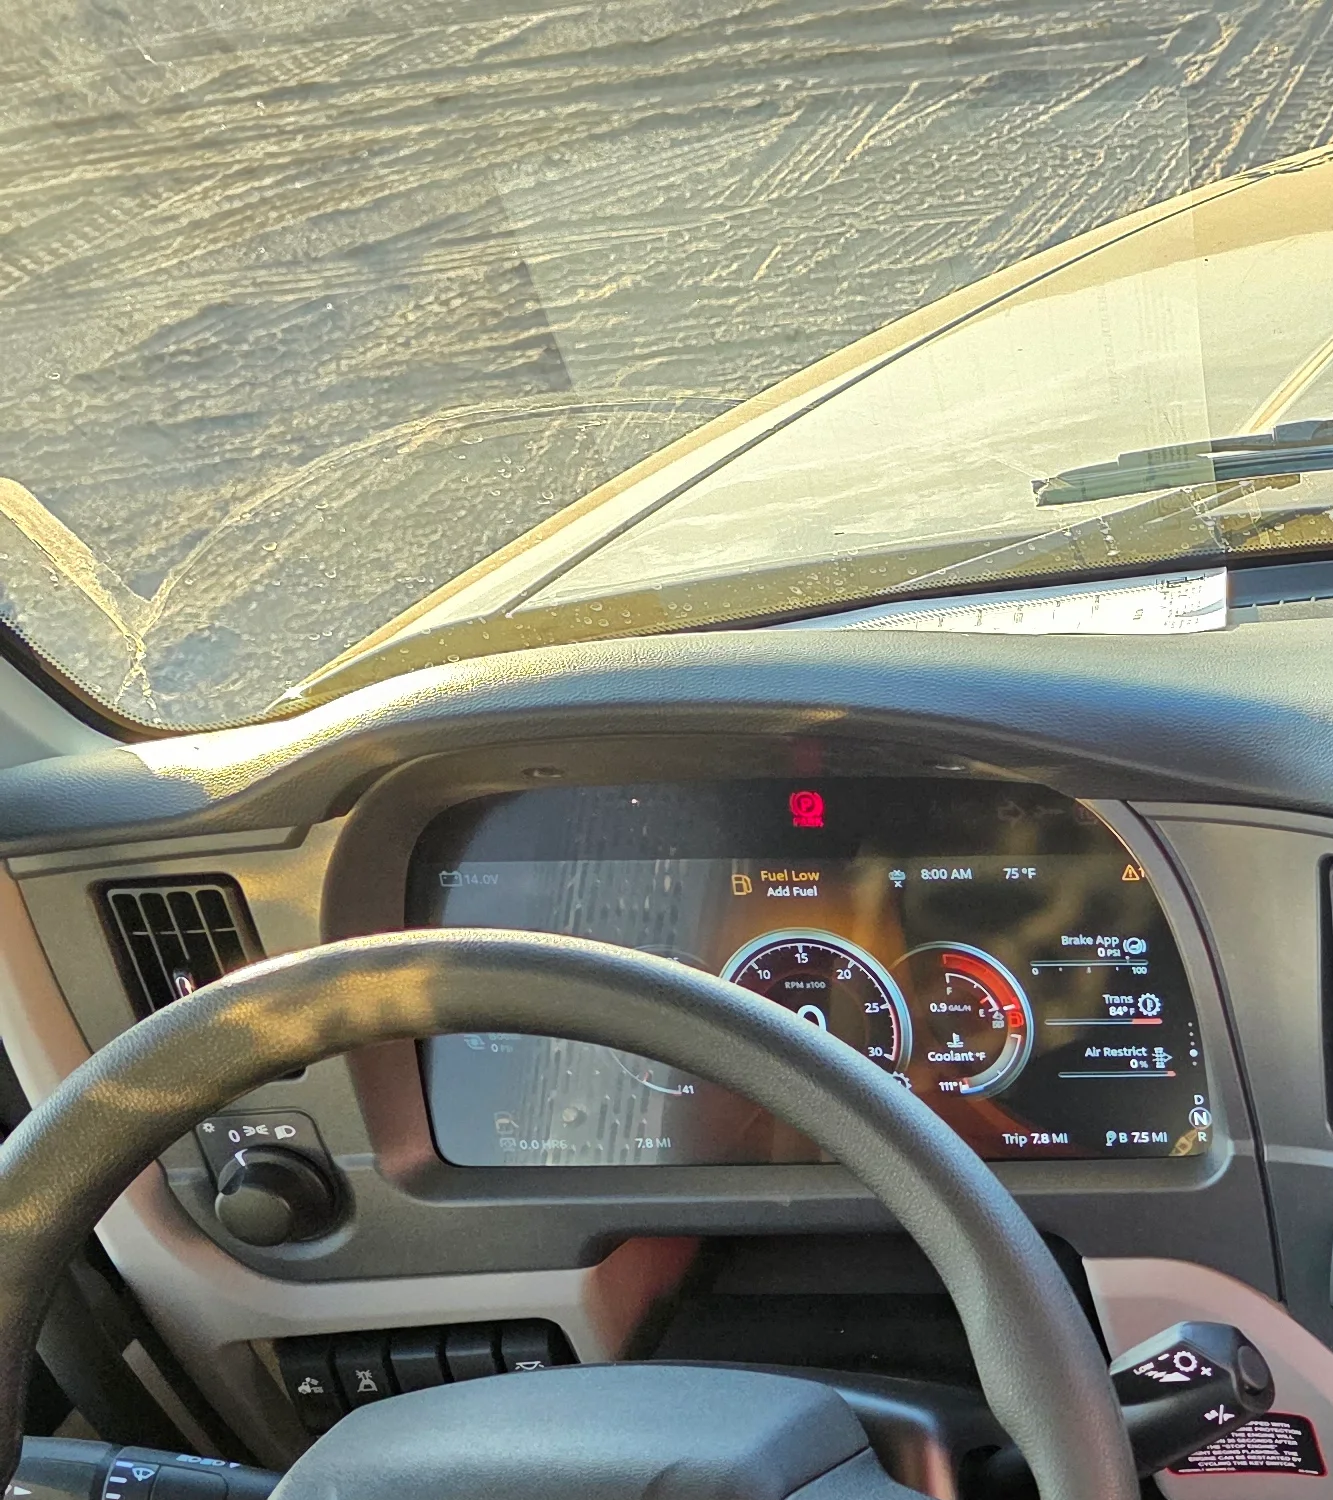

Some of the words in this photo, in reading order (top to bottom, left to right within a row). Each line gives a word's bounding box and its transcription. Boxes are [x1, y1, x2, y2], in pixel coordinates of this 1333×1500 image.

[760, 870, 789, 882] Fuel
[792, 870, 820, 882] Low
[921, 868, 948, 880] 8:00
[950, 868, 972, 880] AM
[1003, 867, 1020, 879] 75
[464, 873, 499, 885] 14.0V
[767, 886, 791, 897] Add
[793, 886, 818, 897] Fuel
[1061, 934, 1093, 946] Brake
[1096, 935, 1120, 947] App
[1097, 947, 1106, 957] 0
[1107, 948, 1121, 957] PSI
[794, 953, 809, 964] 15
[757, 969, 771, 980] 10
[836, 969, 852, 980] 20
[1131, 966, 1148, 975] 100
[784, 981, 805, 989] RPM
[1102, 993, 1134, 1004] Trans
[864, 1002, 880, 1013] 25
[930, 1002, 947, 1013] 0.9
[868, 1046, 882, 1057] 30
[928, 1050, 973, 1062] Coolant
[1085, 1047, 1101, 1057] Air
[1103, 1046, 1148, 1057] Restrict
[1130, 1059, 1139, 1069] 0
[1194, 1095, 1204, 1105] D
[1193, 1112, 1207, 1126] N
[1002, 1133, 1028, 1148] Trip
[1030, 1133, 1050, 1144] 7.8
[1052, 1133, 1068, 1144] MI
[1131, 1131, 1150, 1143] 7.5
[1152, 1131, 1168, 1143] MI
[1198, 1132, 1207, 1142] R
[519, 1139, 538, 1150] 0.0
[635, 1138, 653, 1149] 7.8
[656, 1137, 672, 1148] MI
[1254, 1427, 1302, 1435] PROTECTION
